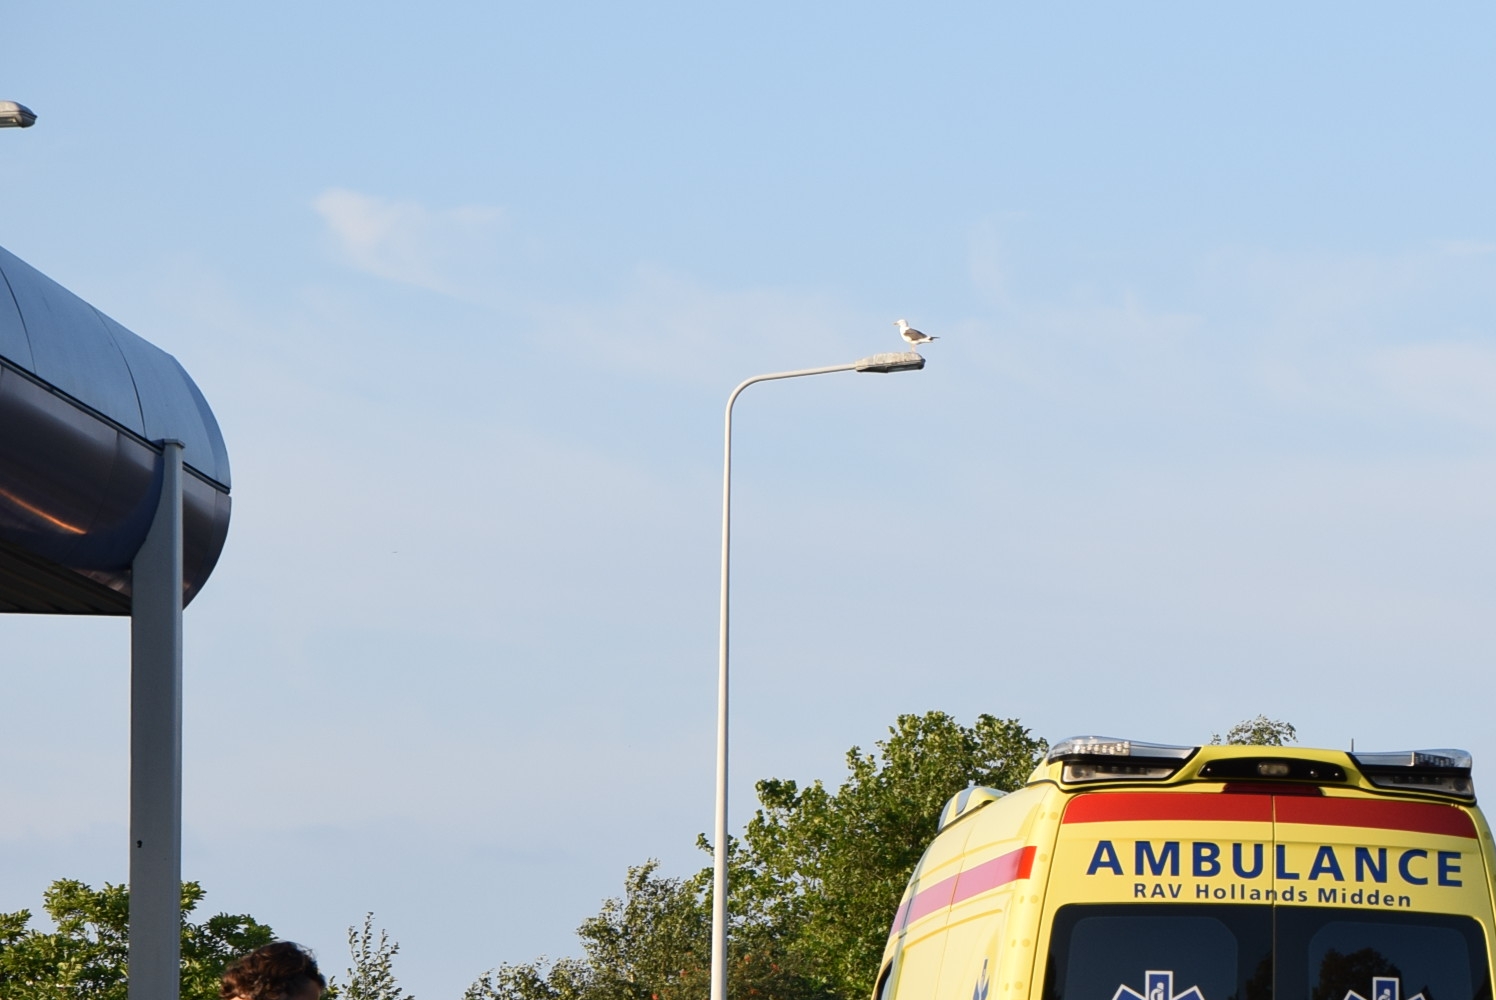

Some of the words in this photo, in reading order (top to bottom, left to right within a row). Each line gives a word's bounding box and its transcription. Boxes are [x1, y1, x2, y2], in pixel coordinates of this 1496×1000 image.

[1086, 840, 1463, 888] AMBULANCE
[1133, 883, 1183, 899] RAV
[1196, 884, 1308, 903] Hollands
[1317, 887, 1412, 908] Midden
